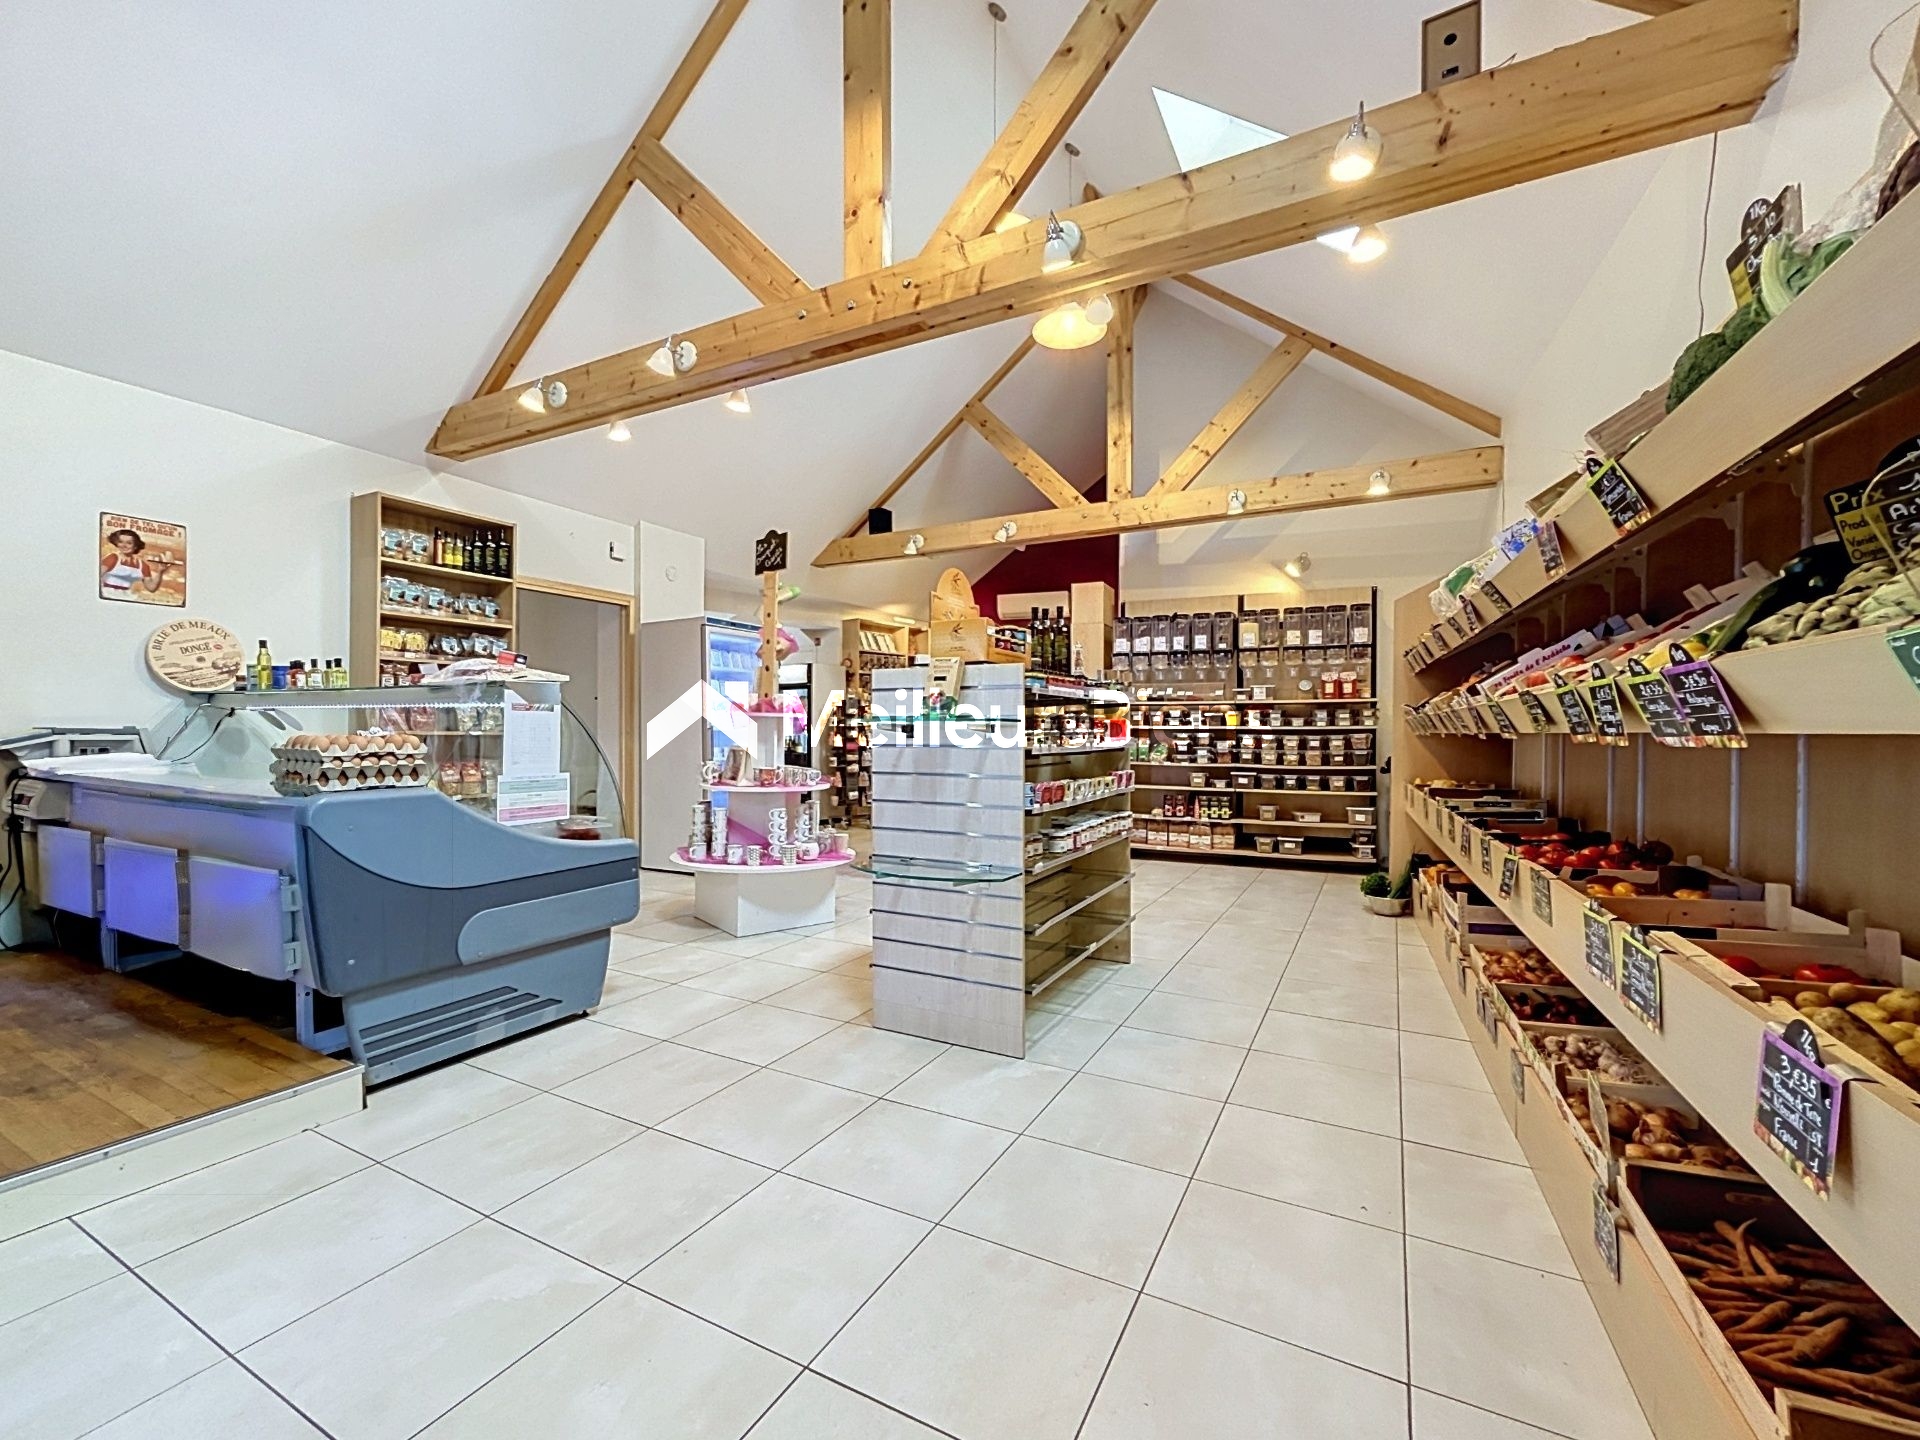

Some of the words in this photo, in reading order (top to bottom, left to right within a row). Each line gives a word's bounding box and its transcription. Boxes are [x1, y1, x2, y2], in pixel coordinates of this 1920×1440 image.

[106, 520, 126, 529] BON
[130, 524, 175, 537] FROMAGE
[151, 629, 171, 651] BRIE
[170, 621, 188, 632] DE
[188, 621, 231, 640] MEAUX
